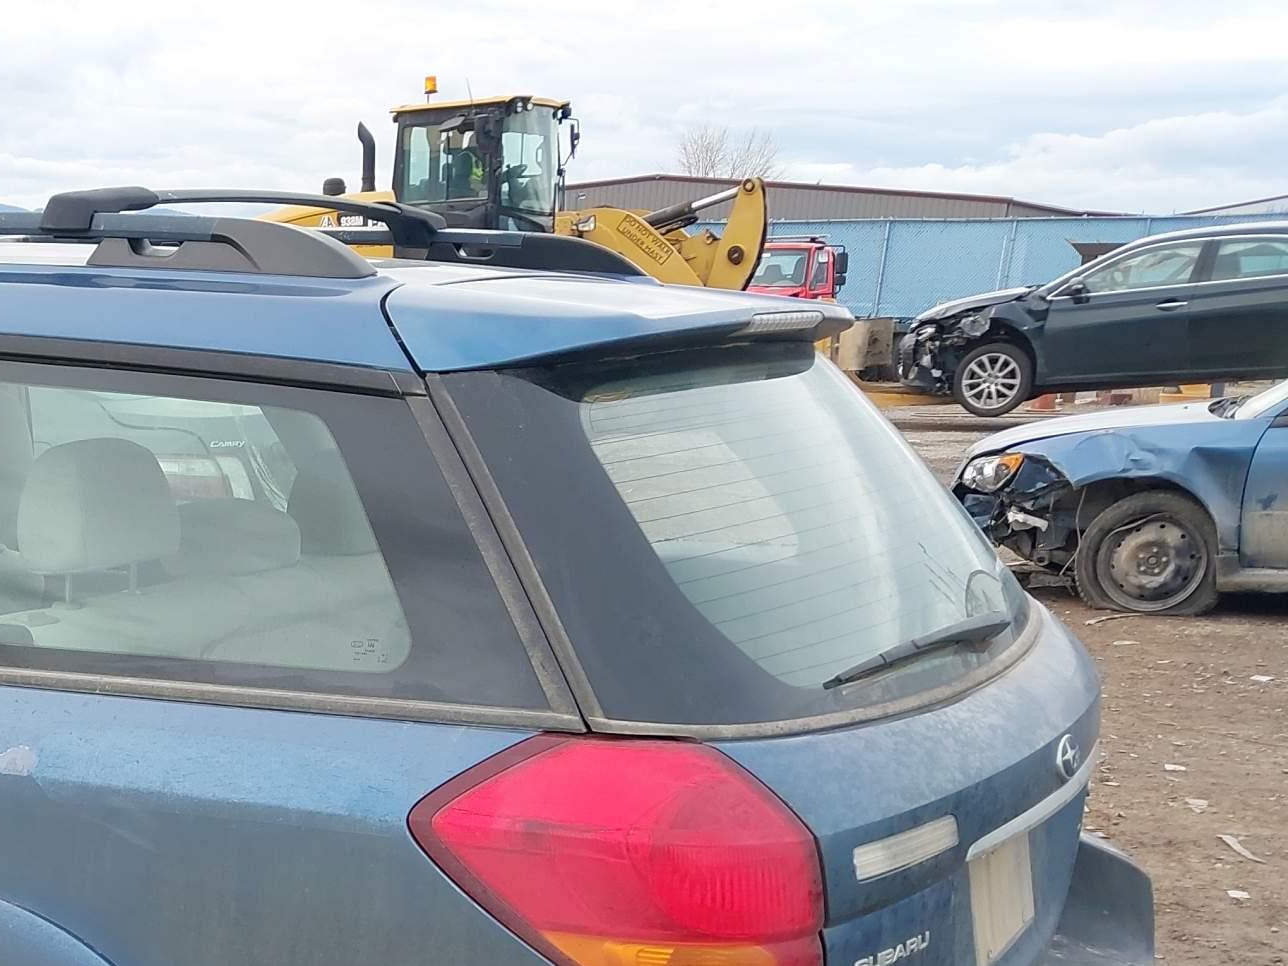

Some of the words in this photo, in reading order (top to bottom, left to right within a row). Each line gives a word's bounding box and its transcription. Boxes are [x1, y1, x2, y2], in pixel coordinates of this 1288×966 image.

[621, 226, 645, 246] UNDER
[644, 245, 663, 260] MAST
[625, 217, 637, 227] DO
[637, 224, 652, 239] NOT
[651, 236, 670, 254] WALK
